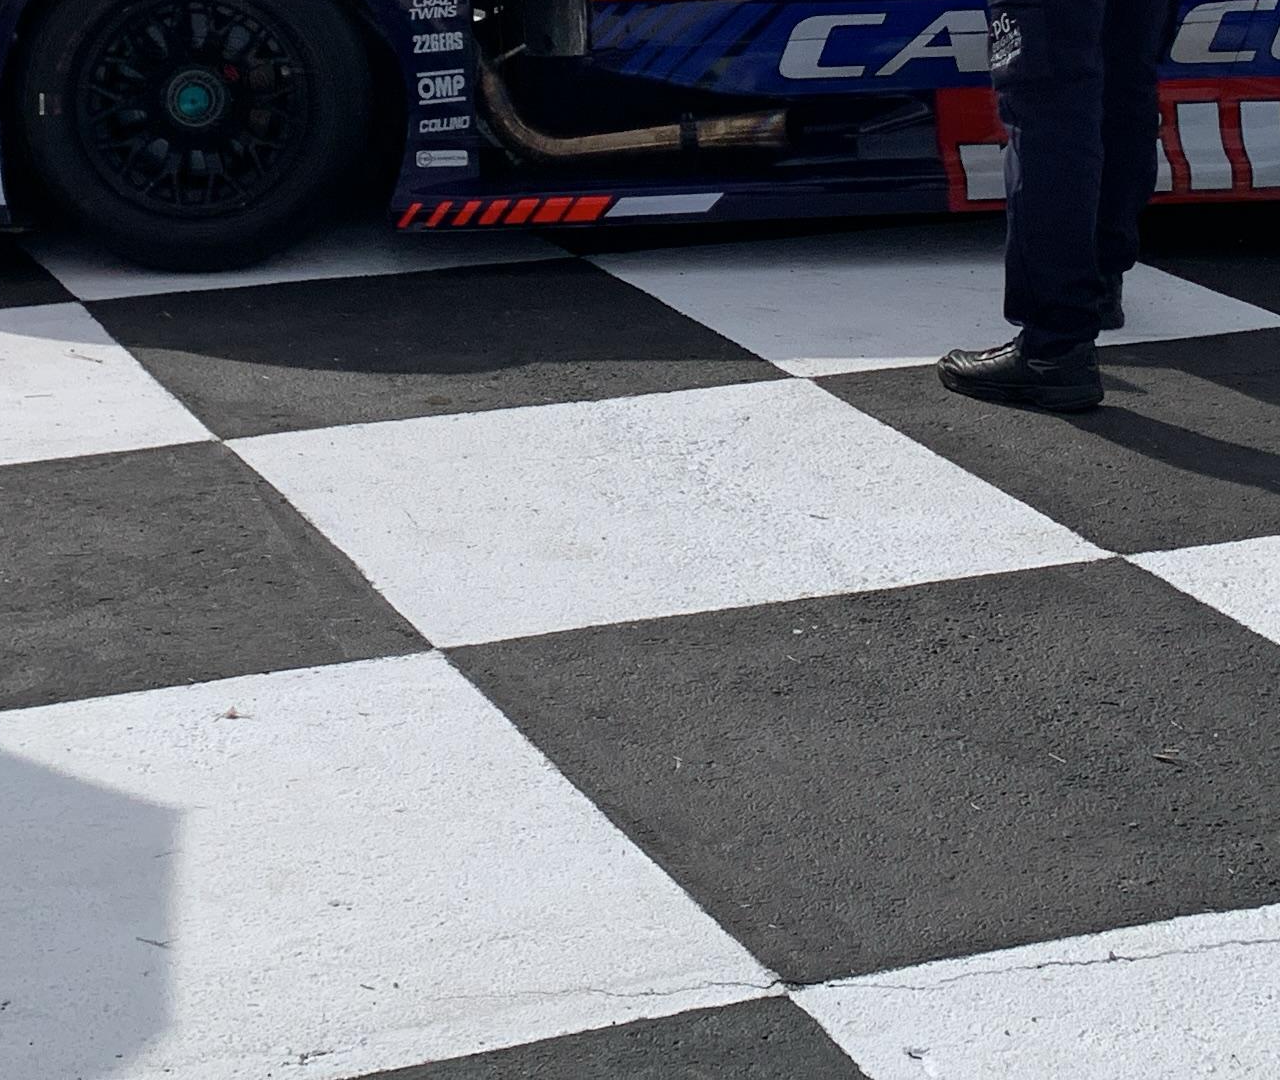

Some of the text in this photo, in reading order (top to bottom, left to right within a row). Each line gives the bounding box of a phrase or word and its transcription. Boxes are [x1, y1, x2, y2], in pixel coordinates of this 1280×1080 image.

[409, 5, 458, 20] TWINS
[412, 32, 464, 53] 226ERS
[417, 74, 465, 99] OMP
[419, 115, 470, 133] COLLINO
